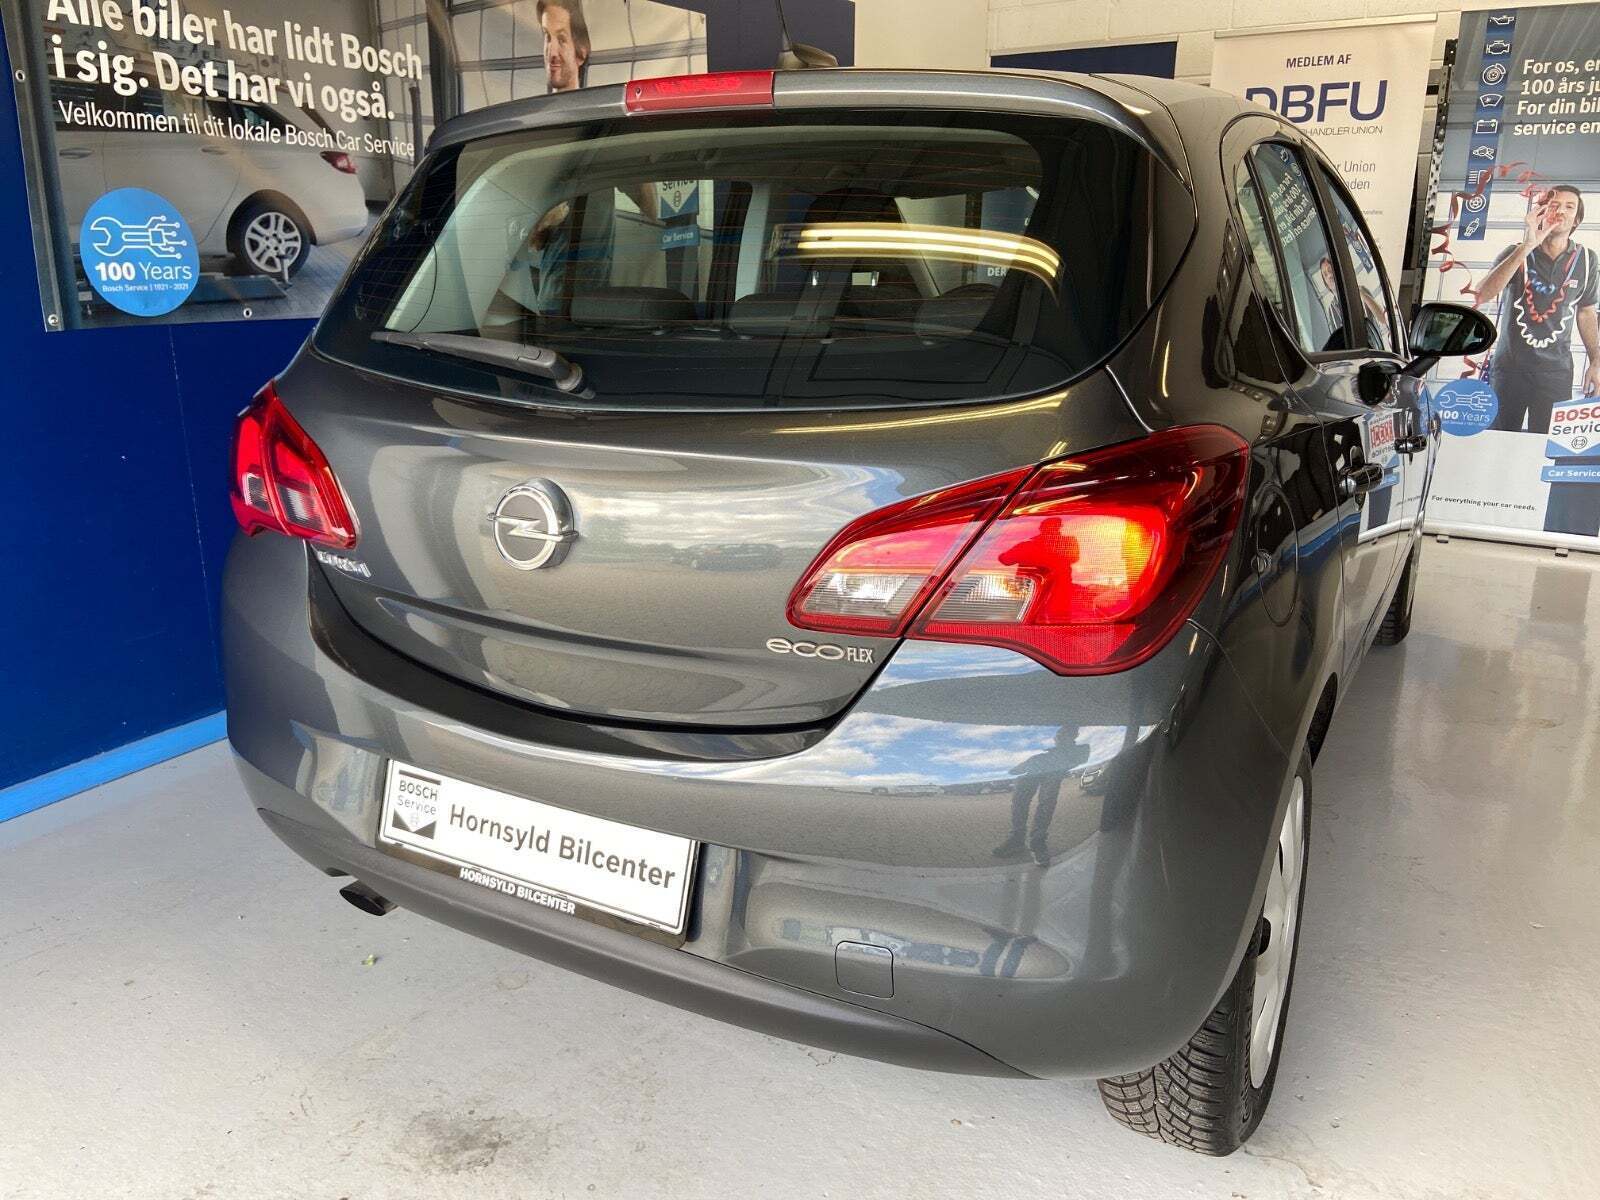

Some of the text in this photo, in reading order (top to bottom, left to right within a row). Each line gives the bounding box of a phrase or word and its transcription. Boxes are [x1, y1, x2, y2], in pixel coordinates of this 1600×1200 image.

[47, 0, 422, 80] Alle biler har lidt Bosch
[1286, 53, 1352, 69] MEDLEM AF
[1523, 58, 1552, 75] For
[1555, 60, 1580, 75] os,
[51, 34, 396, 123] i sig. Det har vi også.
[1521, 78, 1555, 95] 100
[1558, 77, 1585, 93] års
[1517, 96, 1600, 115] For din bil
[58, 100, 415, 157] Velkommen til dit lokale Bosch Car Service
[1351, 124, 1384, 136] UNION
[1513, 119, 1600, 136] service en
[1344, 160, 1376, 172] Union
[95, 261, 193, 281] 100 Years
[102, 284, 123, 293] Bosch
[125, 283, 148, 292] Service
[1440, 409, 1490, 423] 100 Years
[1554, 406, 1600, 423] BOSC
[1552, 421, 1600, 436] Servic
[1548, 467, 1564, 477] Car
[1444, 496, 1481, 506] everything
[1483, 500, 1498, 508] your
[399, 780, 438, 800] BOSCH
[397, 795, 437, 815] Service
[450, 804, 676, 888] Hornsyld Bilcenter
[460, 867, 576, 914] HORNSYLD BILCENTER
